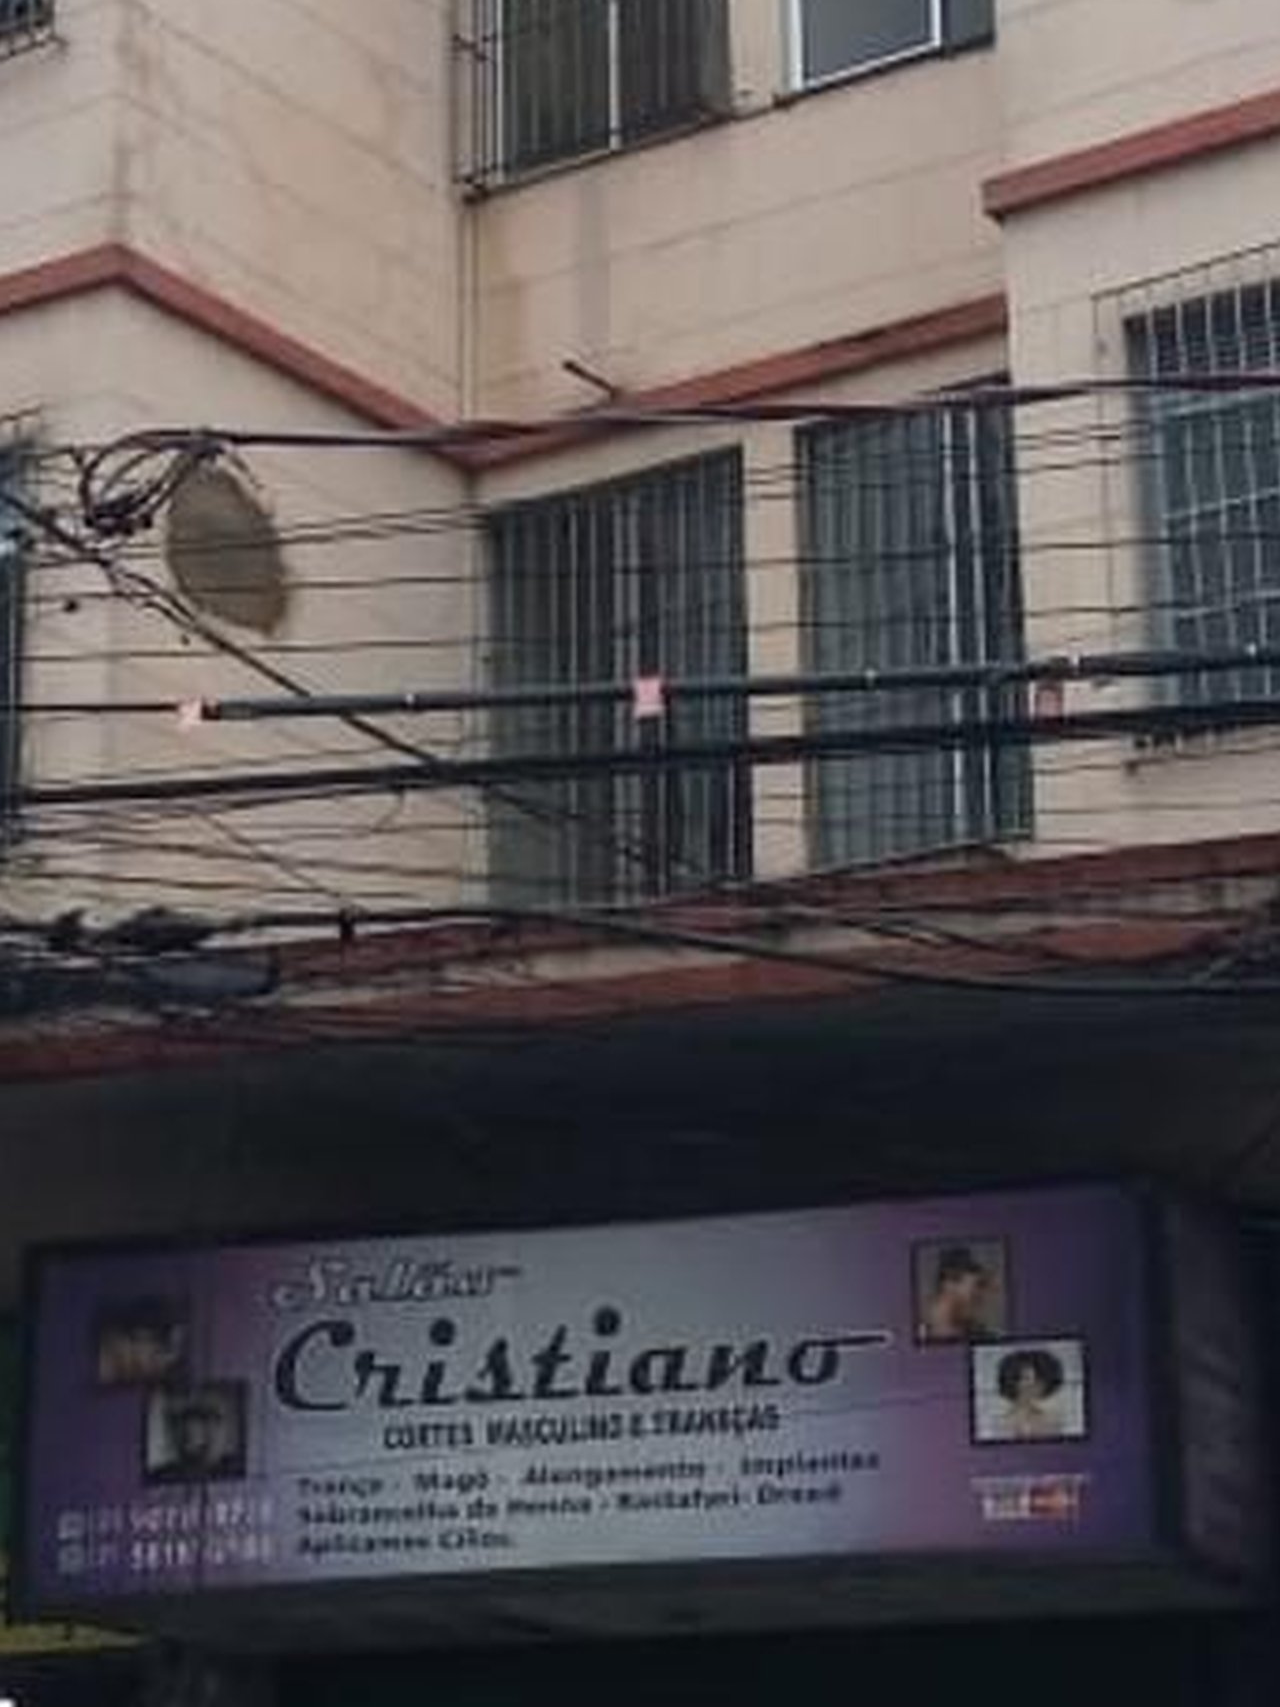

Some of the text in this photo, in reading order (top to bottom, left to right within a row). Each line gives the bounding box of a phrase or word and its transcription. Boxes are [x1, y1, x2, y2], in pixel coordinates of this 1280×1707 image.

[274, 1304, 893, 1412] Cristiano
[383, 1422, 473, 1449] CORTES
[487, 1413, 623, 1447] MASCULINO
